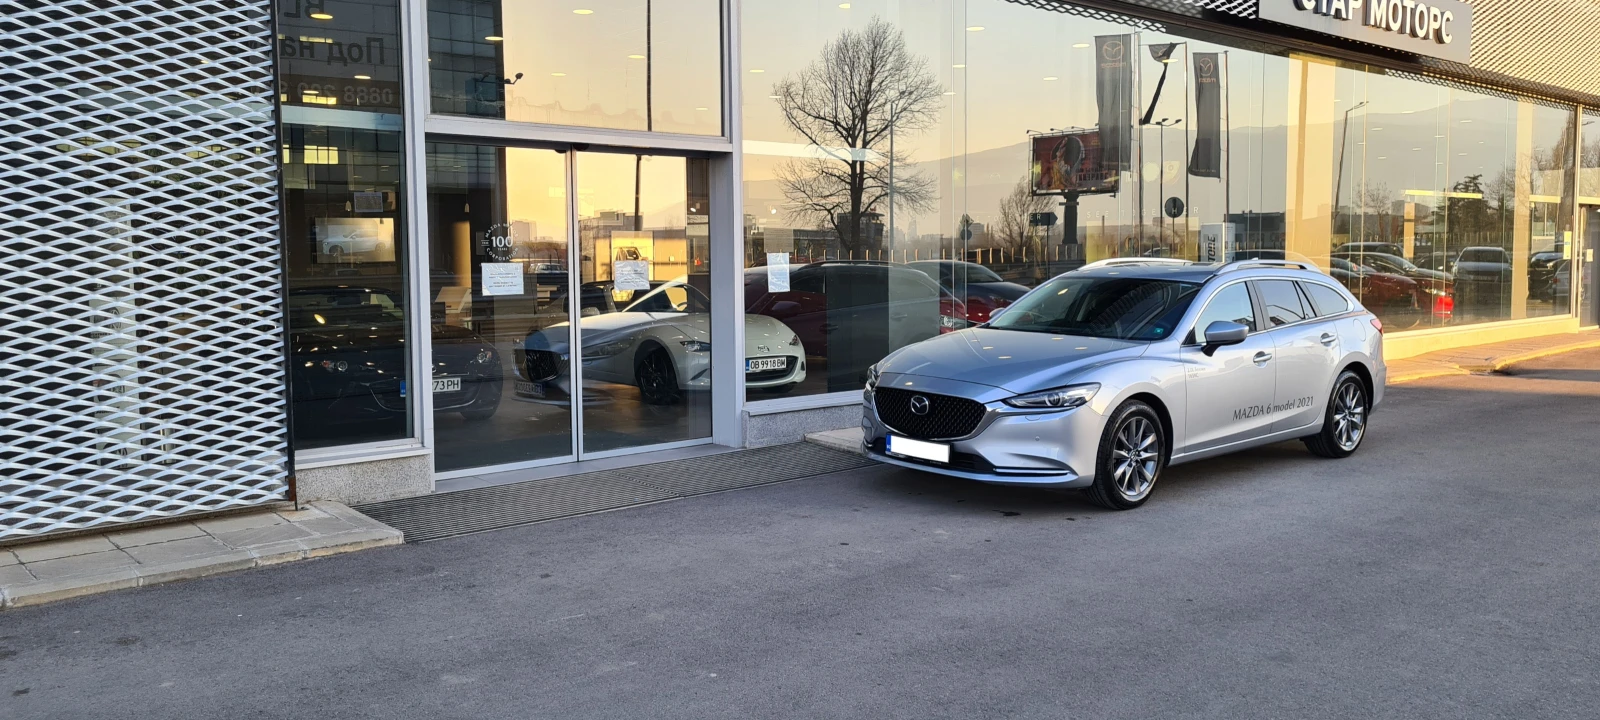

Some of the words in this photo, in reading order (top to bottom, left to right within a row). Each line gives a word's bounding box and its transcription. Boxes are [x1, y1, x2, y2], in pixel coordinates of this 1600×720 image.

[1370, 0, 1454, 44] МОТОРС
[1086, 210, 1109, 219] SEE
[1121, 206, 1199, 217] TOGEHER
[485, 222, 501, 238] MAZDA
[491, 236, 513, 248] 100
[486, 247, 519, 261] CORPORATION
[1232, 404, 1265, 421] MAZDA
[1266, 403, 1272, 415] 6
[1273, 399, 1296, 413] model
[1296, 396, 1314, 408] 2021
